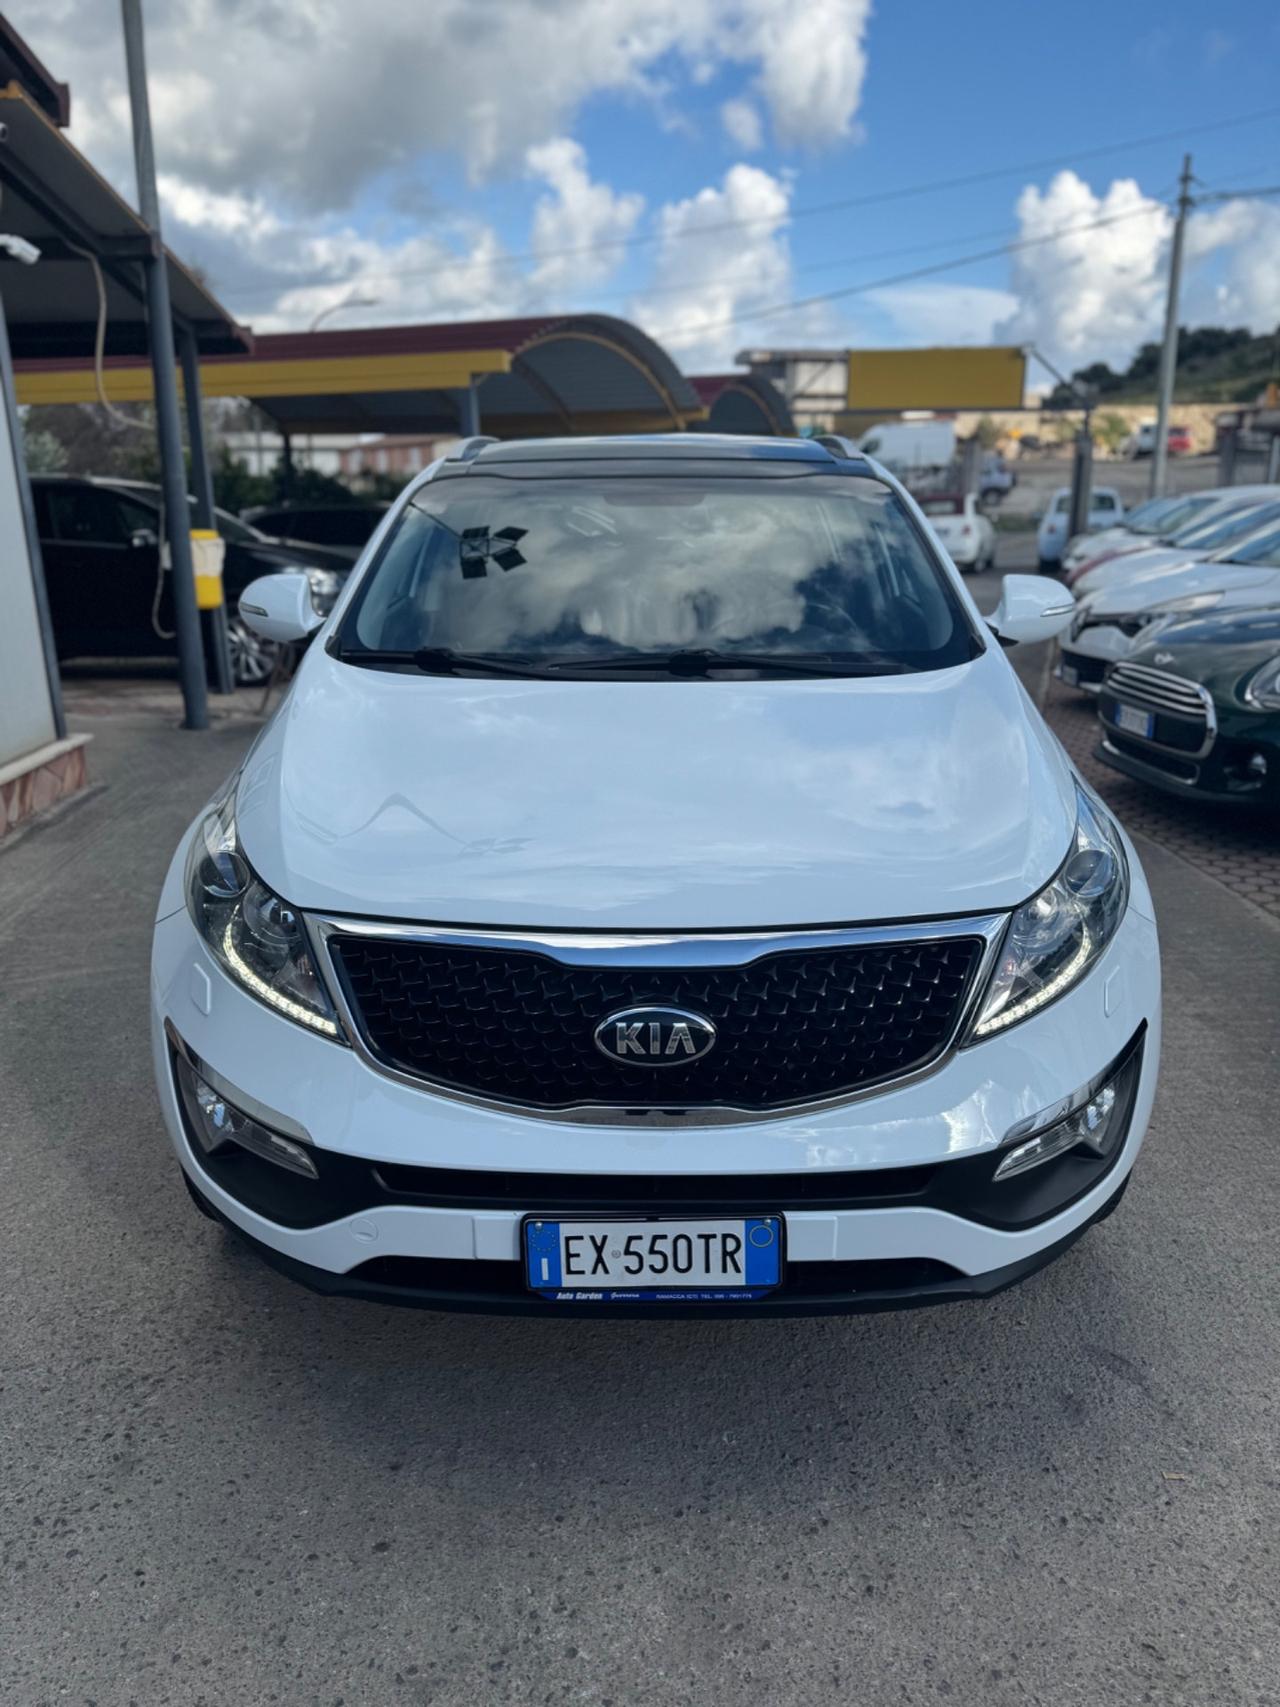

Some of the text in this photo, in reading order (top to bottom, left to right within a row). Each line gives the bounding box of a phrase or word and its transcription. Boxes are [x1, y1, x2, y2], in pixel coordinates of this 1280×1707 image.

[615, 1022, 697, 1055] KIA
[564, 1233, 742, 1275] EX 550TR
[556, 1292, 574, 1300] Auto
[575, 1292, 603, 1300] Garden
